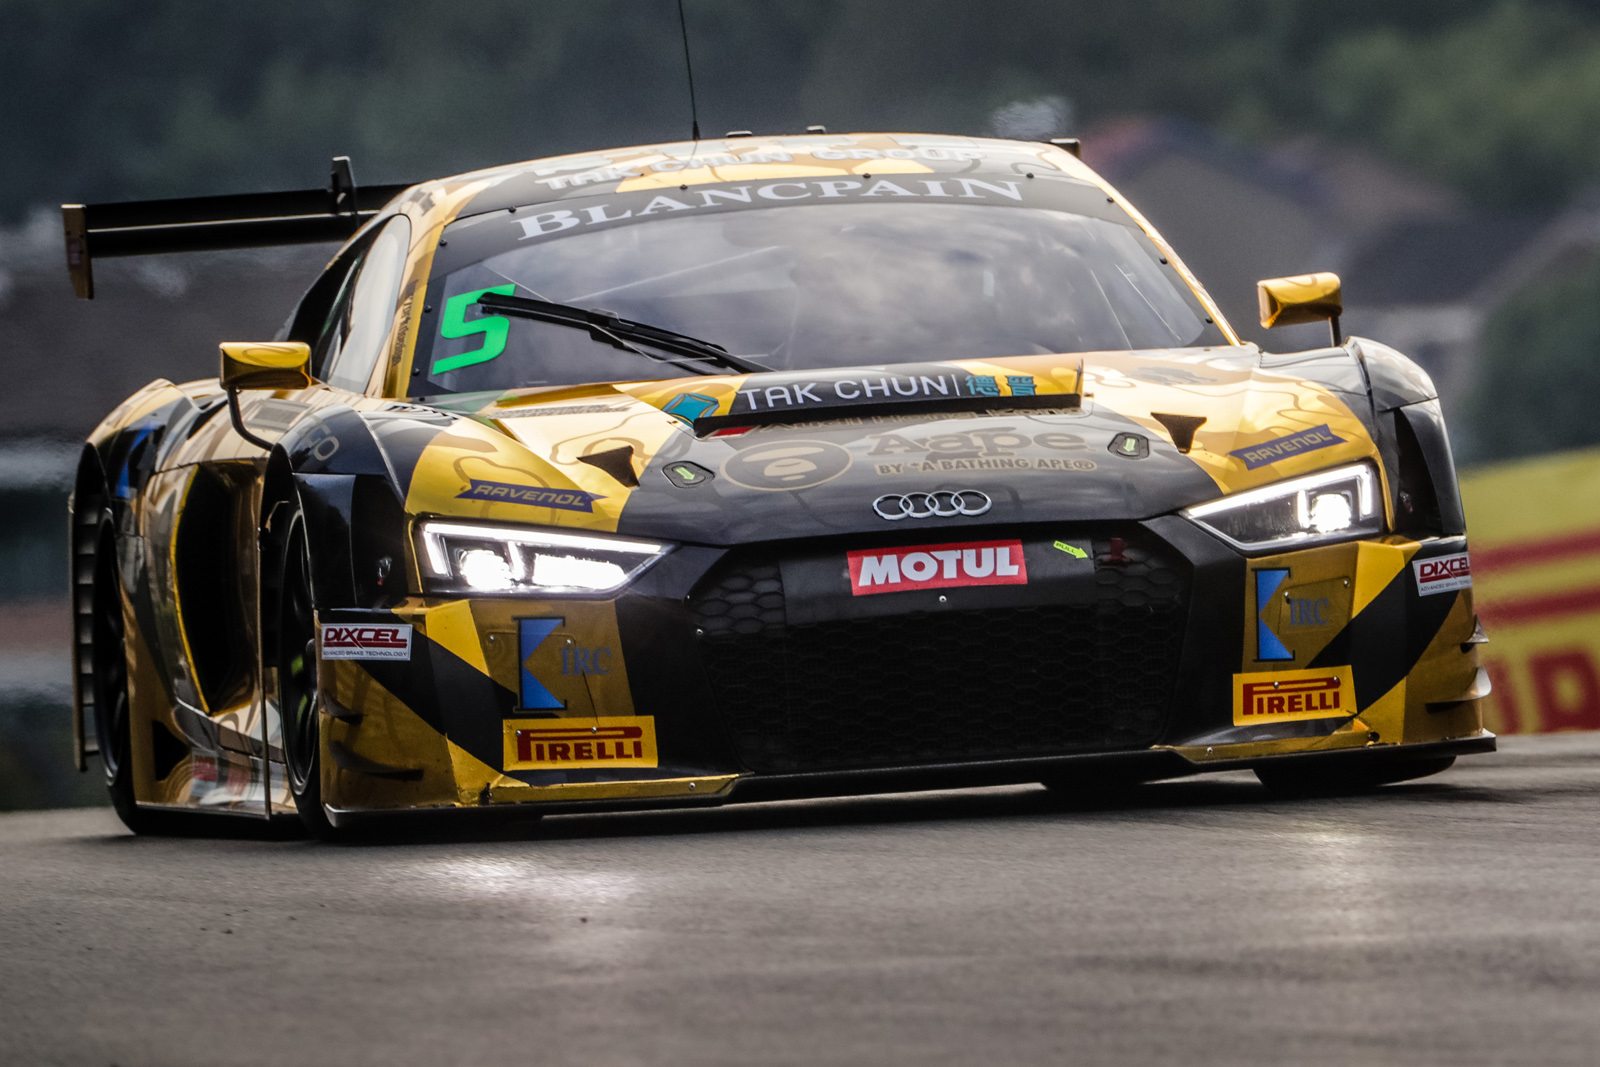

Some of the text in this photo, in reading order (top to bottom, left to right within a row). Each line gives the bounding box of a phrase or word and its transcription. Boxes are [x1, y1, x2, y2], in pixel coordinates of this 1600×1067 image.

[510, 177, 1025, 241] BLANCPAIN
[432, 284, 516, 375] 5
[736, 375, 949, 411] TAK CHUN
[866, 431, 1088, 458] Aape
[1243, 432, 1333, 463] RAVENOL
[877, 464, 903, 475] BY
[941, 458, 1030, 470] BATHING
[473, 485, 585, 506] RAVENOL
[858, 546, 1020, 586] MOTUL
[1420, 557, 1470, 579] DIXCEL
[324, 628, 407, 649] DIXCEL
[1242, 676, 1341, 715] PIRELLI
[517, 726, 643, 761] PIRELLI
